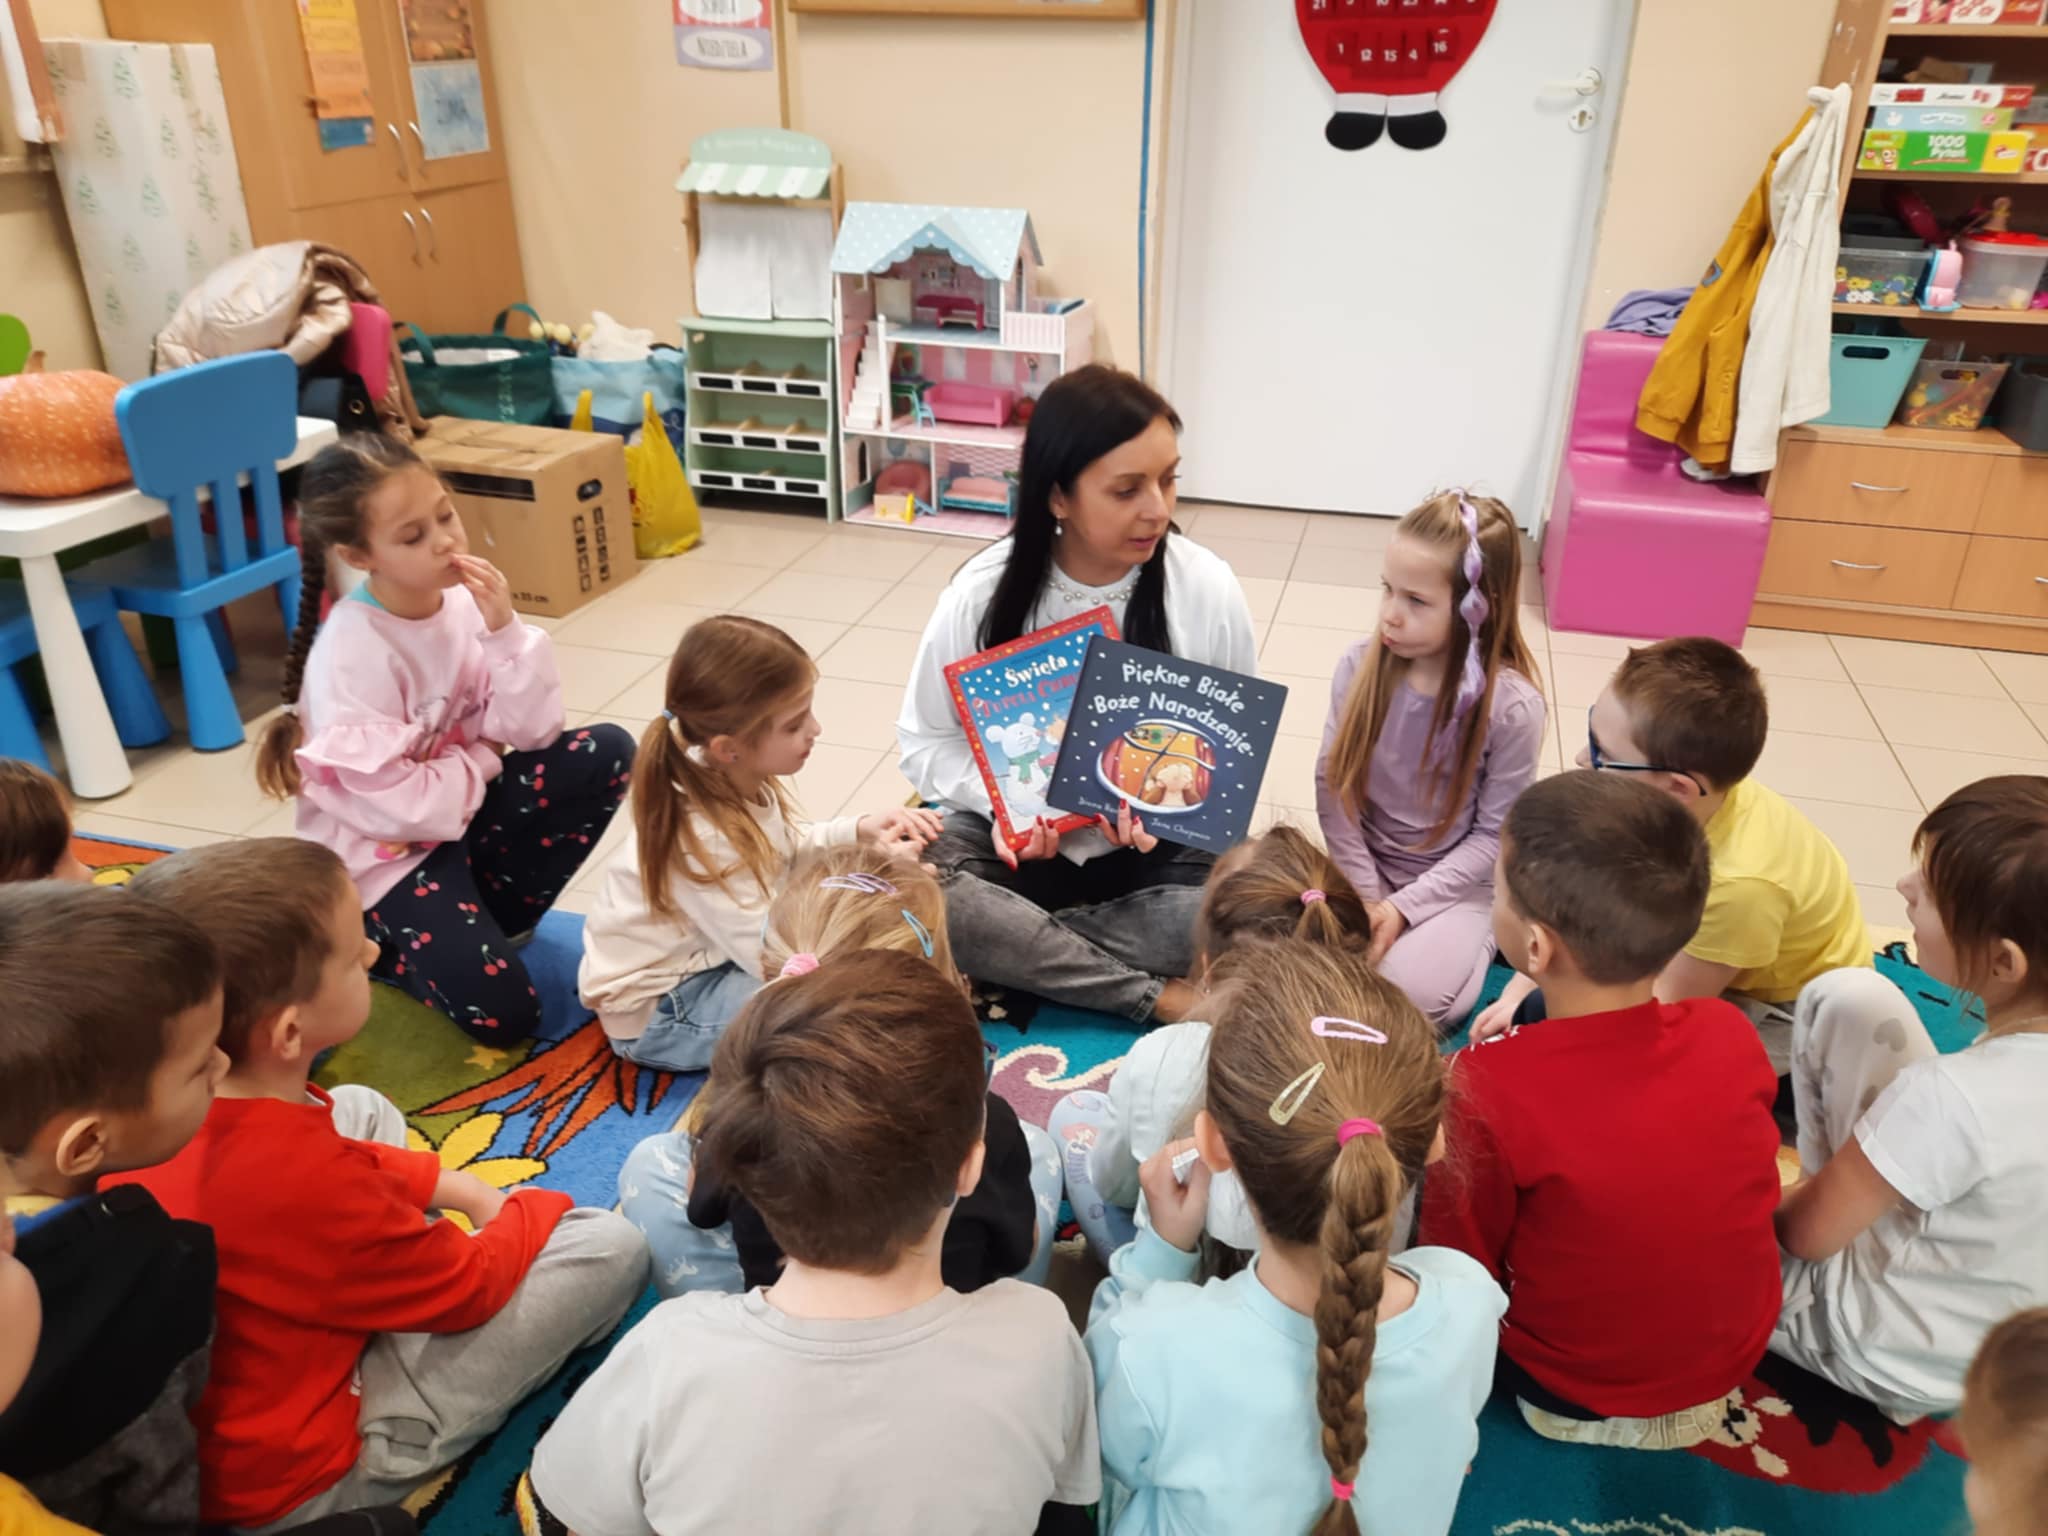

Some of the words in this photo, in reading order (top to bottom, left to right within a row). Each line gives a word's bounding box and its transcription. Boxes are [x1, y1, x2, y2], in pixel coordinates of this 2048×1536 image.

[1338, 42, 1344, 55] 1
[1384, 49, 1398, 62] 15
[1408, 48, 1418, 61] 4
[1432, 40, 1448, 54] 16
[1928, 134, 1967, 148] 1000
[1004, 654, 1068, 688] Święta
[1122, 663, 1191, 688] Piękne
[1196, 675, 1245, 714] Białe
[1093, 693, 1141, 714] Boże
[1148, 691, 1252, 754] Narodzenie
